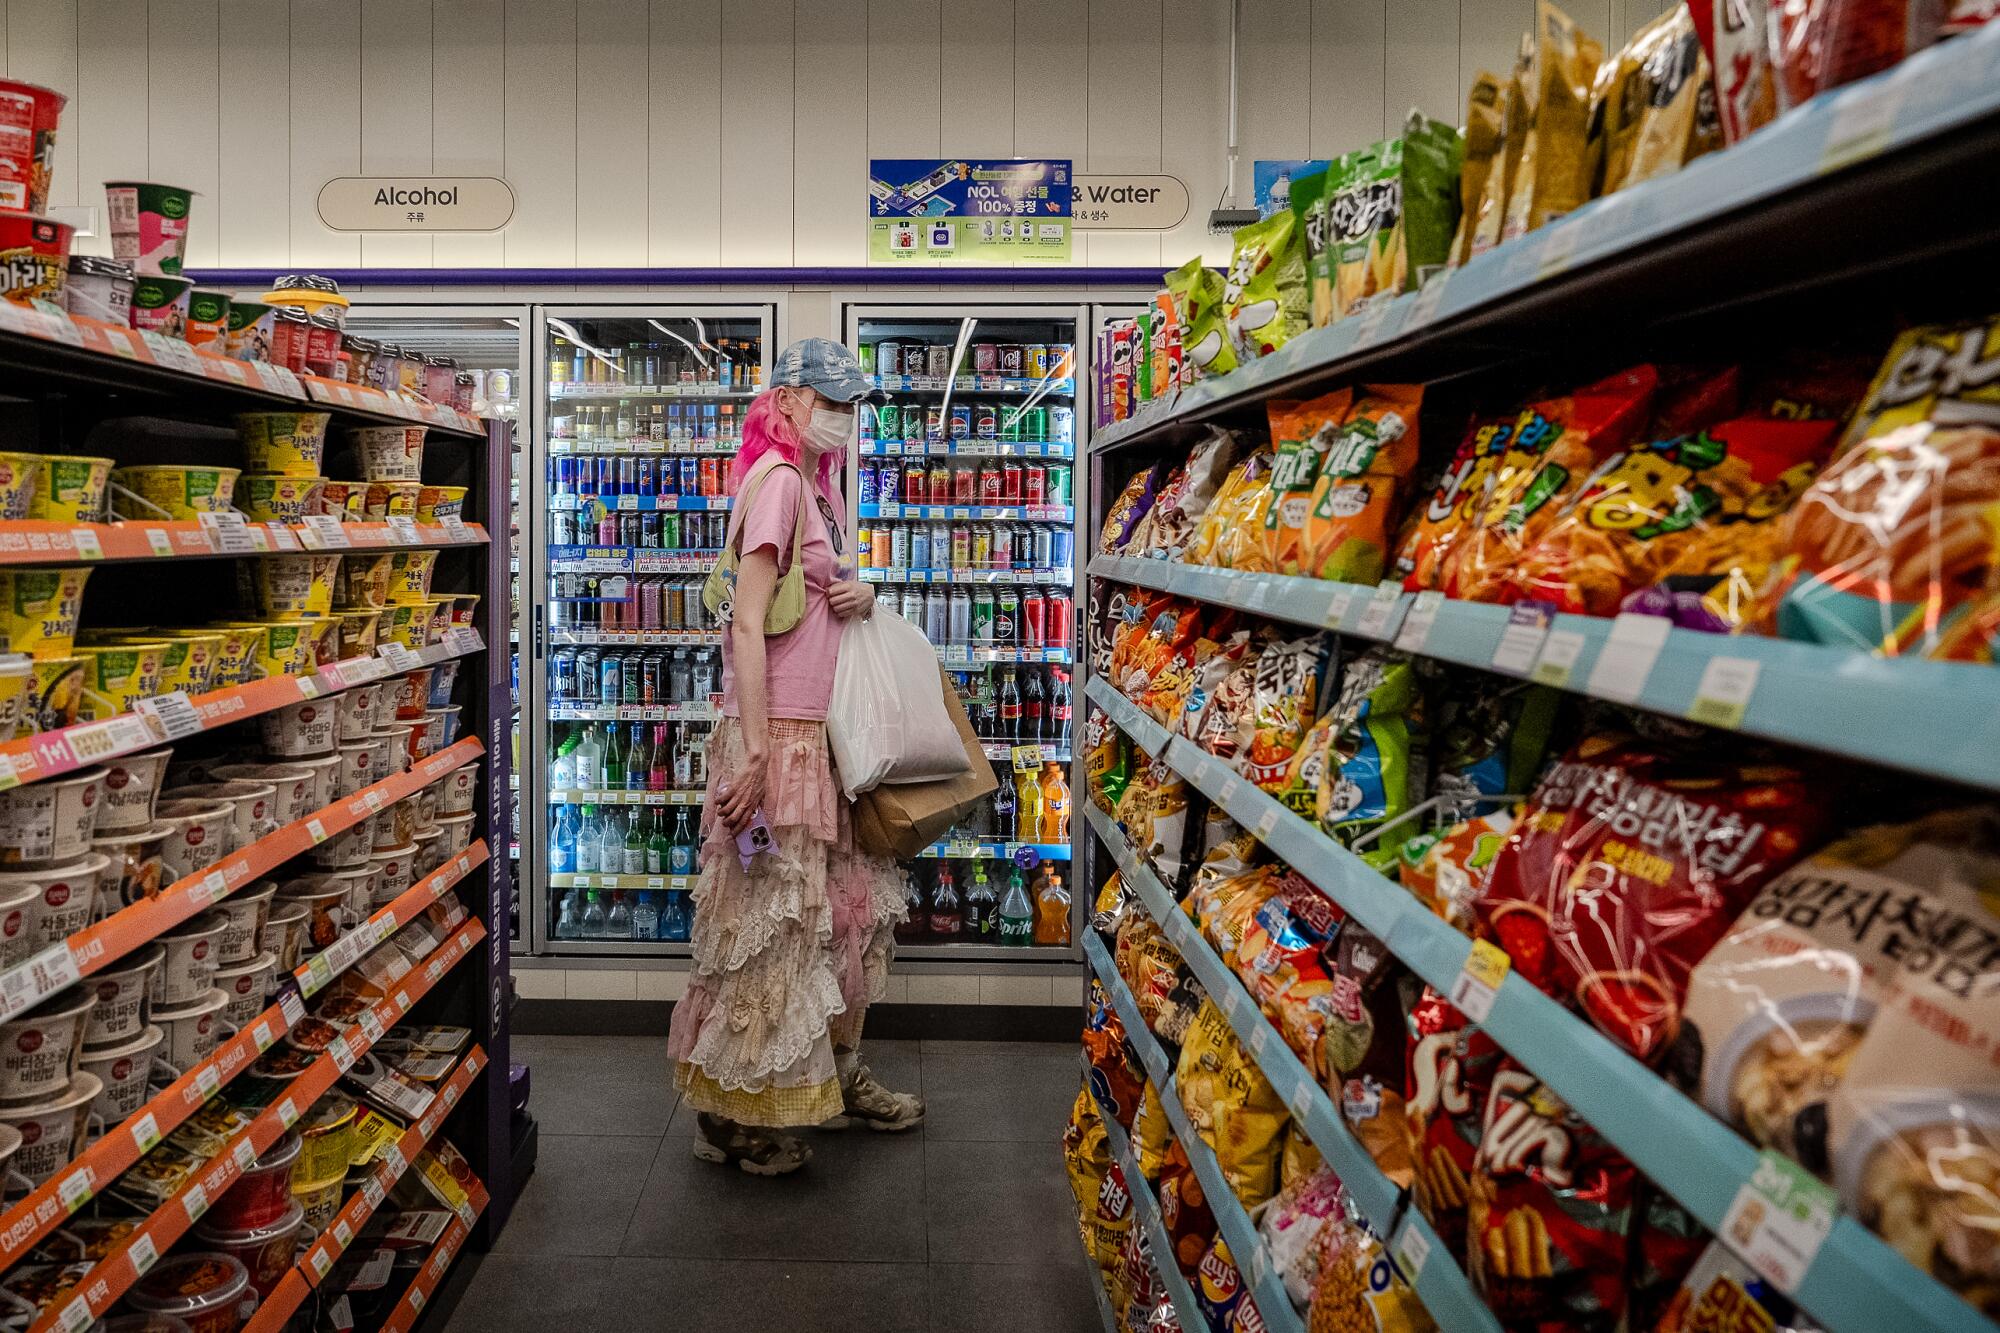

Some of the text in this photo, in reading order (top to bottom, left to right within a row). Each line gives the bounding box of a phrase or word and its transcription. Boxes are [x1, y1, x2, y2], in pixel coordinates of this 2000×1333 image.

[374, 187, 458, 206] Alcohol
[967, 186, 999, 200] NOL
[1026, 186, 1048, 199] 선물
[1072, 186, 1160, 203] & Water
[977, 200, 1036, 213] 100% 증정
[406, 212, 425, 223] 주류
[1081, 211, 1088, 220] &
[1090, 210, 1109, 221] 생수
[404, 570, 423, 583] 제육
[408, 624, 424, 636] 제육
[40, 739, 71, 765] 1+1
[1000, 917, 1033, 935] Sprite
[20, 1066, 56, 1082] 비빔밥
[1200, 1252, 1237, 1289] Lay's
